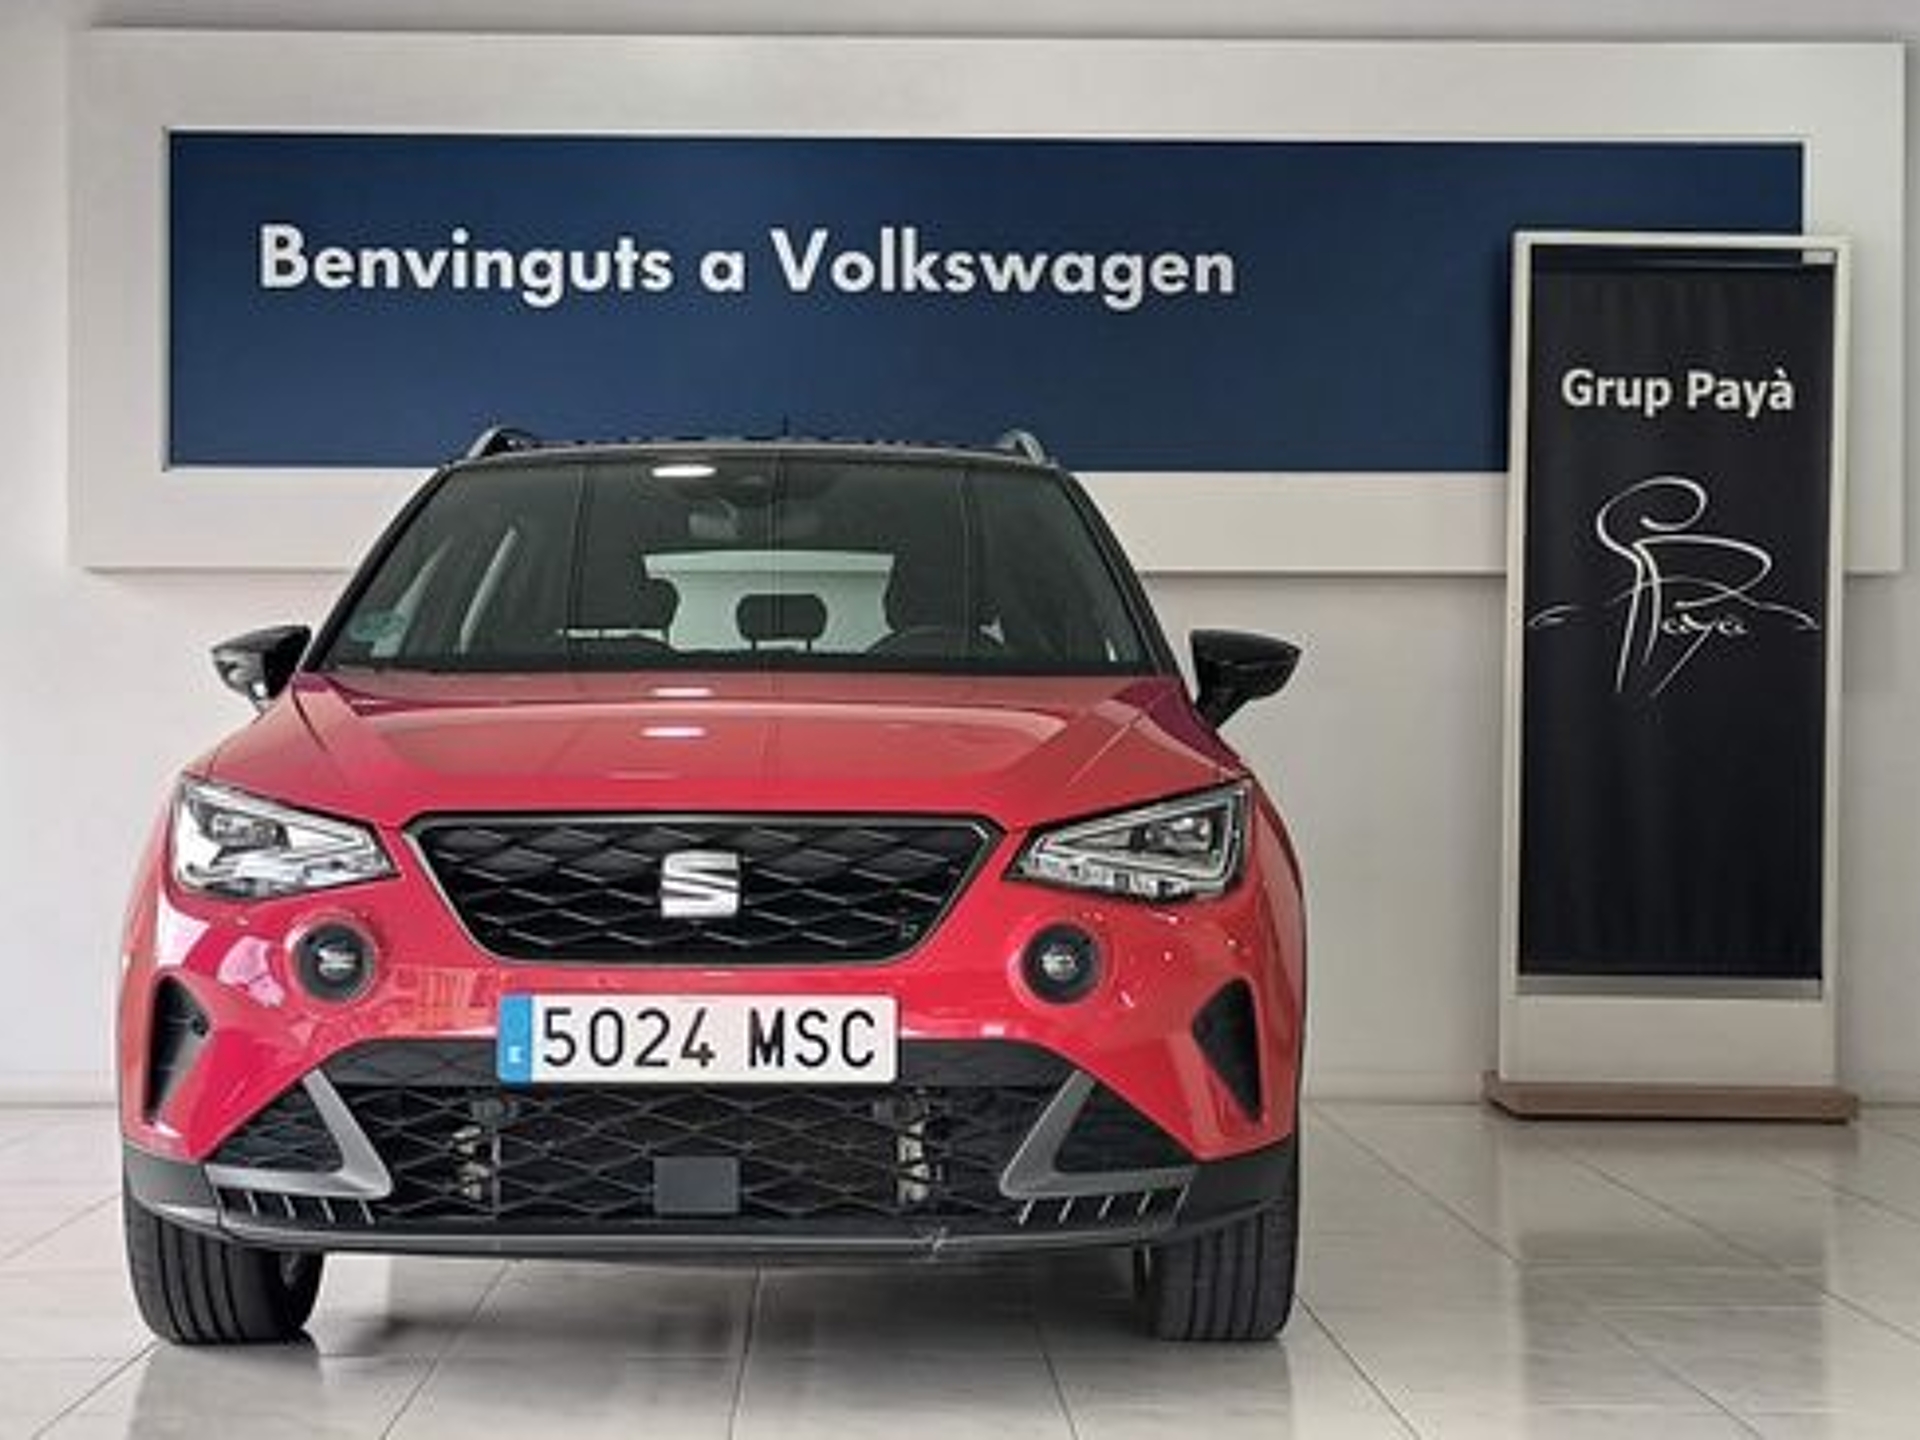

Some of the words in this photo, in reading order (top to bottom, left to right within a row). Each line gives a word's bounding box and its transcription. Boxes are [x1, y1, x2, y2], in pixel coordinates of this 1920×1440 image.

[260, 223, 674, 308] Benvinguts
[700, 250, 746, 293] a
[769, 226, 1235, 310] Volkswagen
[1560, 367, 1673, 418] Grup
[1686, 366, 1795, 419] Payà
[543, 1007, 716, 1068] 5024
[748, 1008, 876, 1068] MSC
